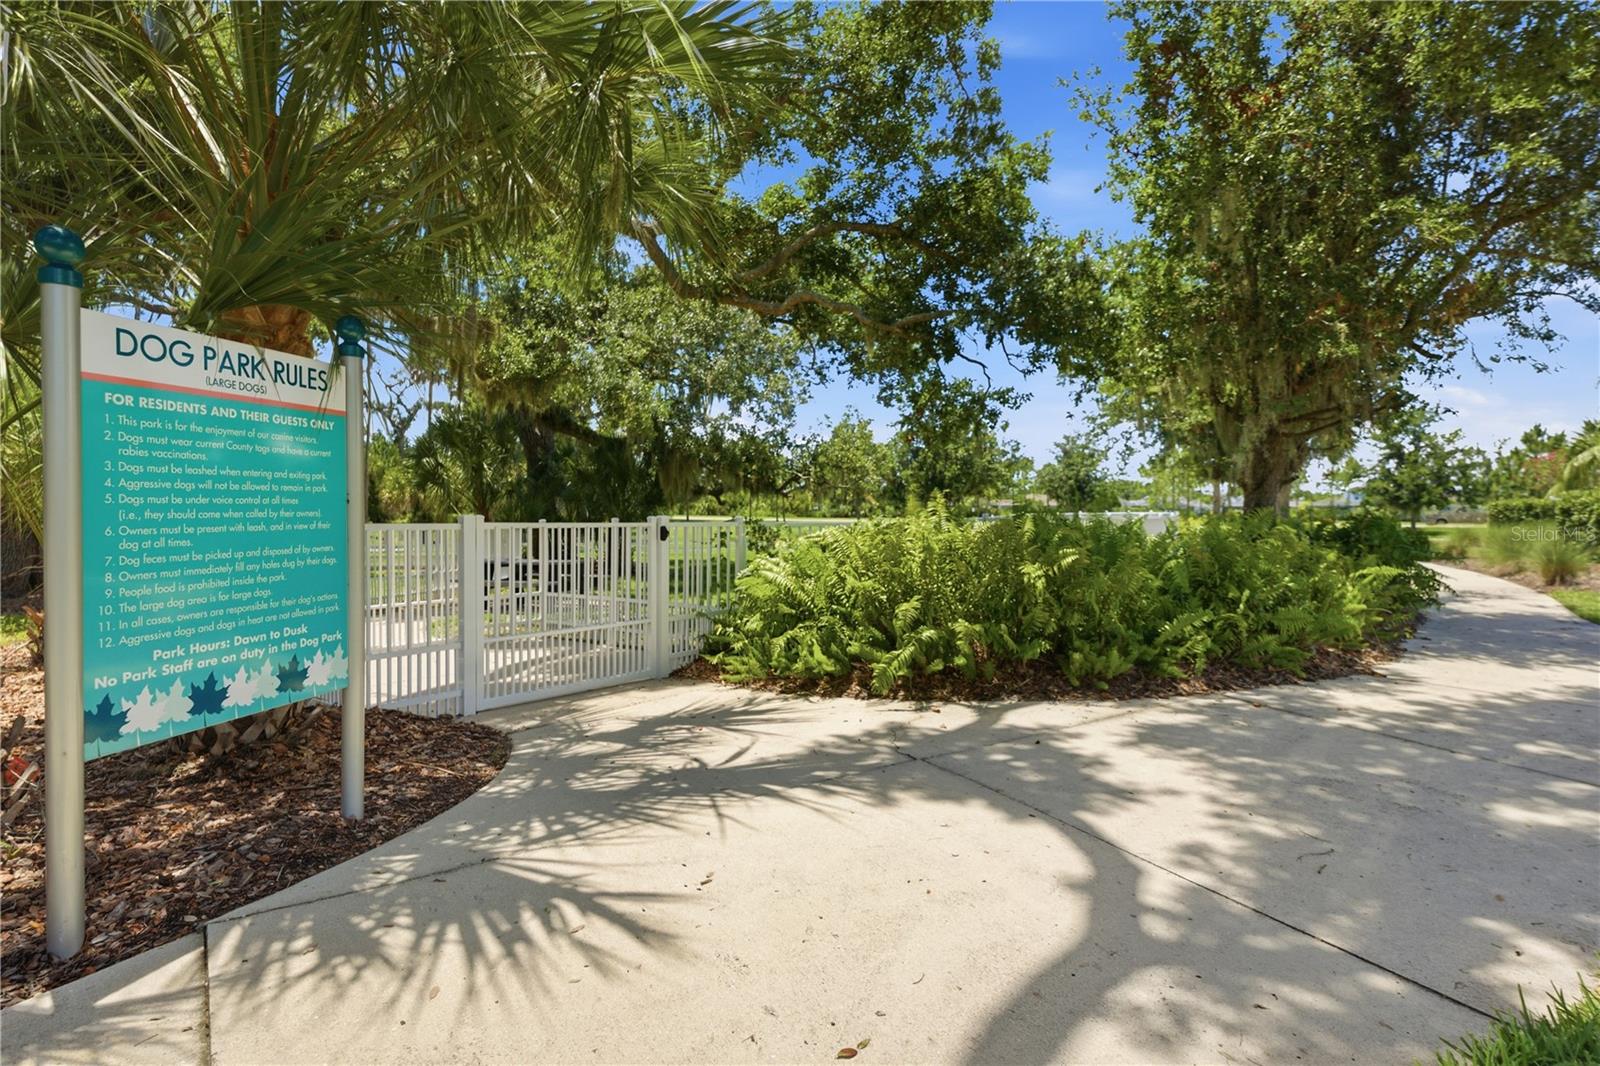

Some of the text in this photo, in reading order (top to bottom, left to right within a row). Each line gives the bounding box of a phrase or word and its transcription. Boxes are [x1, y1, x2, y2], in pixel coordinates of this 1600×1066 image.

[116, 327, 328, 392] DOG PARK RULES
[206, 376, 267, 394] (LARGE DOGS)
[104, 392, 335, 431] FOR RESIDENTS AND THEIR GUESTS ONLY
[105, 413, 114, 425] 1.
[117, 414, 137, 427] This
[140, 418, 162, 430] park
[165, 420, 172, 430] is
[175, 420, 188, 431] for
[190, 421, 203, 433] the
[205, 423, 246, 437] enjoyment
[247, 428, 256, 437] of
[257, 431, 269, 439] our
[271, 432, 294, 442] canine
[104, 430, 332, 457] 2. Dogs must wear current County tags and have current
[118, 445, 208, 461] rabies vaccinations.
[104, 460, 311, 482] 3. Dogs must be leashed when entering and exiting
[104, 477, 115, 488] 4.
[118, 478, 172, 491] Aggressive
[174, 479, 196, 492] dogs
[197, 479, 212, 490] will
[214, 481, 228, 490] not
[229, 480, 240, 491] be
[241, 480, 270, 491] allowed
[271, 483, 279, 491] to
[280, 483, 303, 492] remain
[104, 493, 280, 507] 5. Dogs must be under voice control all
[119, 509, 141, 521] (i.e.,
[144, 508, 165, 522] they
[167, 508, 196, 519] should
[222, 508, 244, 518] when
[245, 507, 267, 518] called
[268, 508, 278, 520] by
[279, 508, 295, 517] their
[104, 526, 115, 536] 6.
[118, 525, 157, 536] Owners
[160, 526, 181, 535] must
[183, 523, 195, 534] be
[197, 525, 227, 535] present
[229, 522, 245, 532] with
[270, 521, 284, 531] and
[293, 521, 308, 530] view
[104, 544, 311, 568] 7. Dog feces must be picked up and disposed by
[118, 536, 193, 552] dog at all times.
[104, 557, 305, 583] 8. Owners must immediately any holes dug by
[104, 588, 115, 599] 9.
[119, 584, 152, 599] People
[154, 583, 176, 594] food
[178, 582, 185, 592] is
[187, 577, 230, 592] prohibited
[232, 575, 255, 586] inside
[256, 573, 267, 583] the
[99, 590, 252, 616] 10. The large dog area for large
[99, 594, 316, 633] 11. In all cases, owners are responsible for dog's
[99, 606, 317, 649] 12. Aggressive dogs and dogs heat are not allowed
[153, 624, 308, 661] Park Hours: Dawn to Dusk
[94, 630, 342, 690] No Park Staff are on duty in the Dog Park
